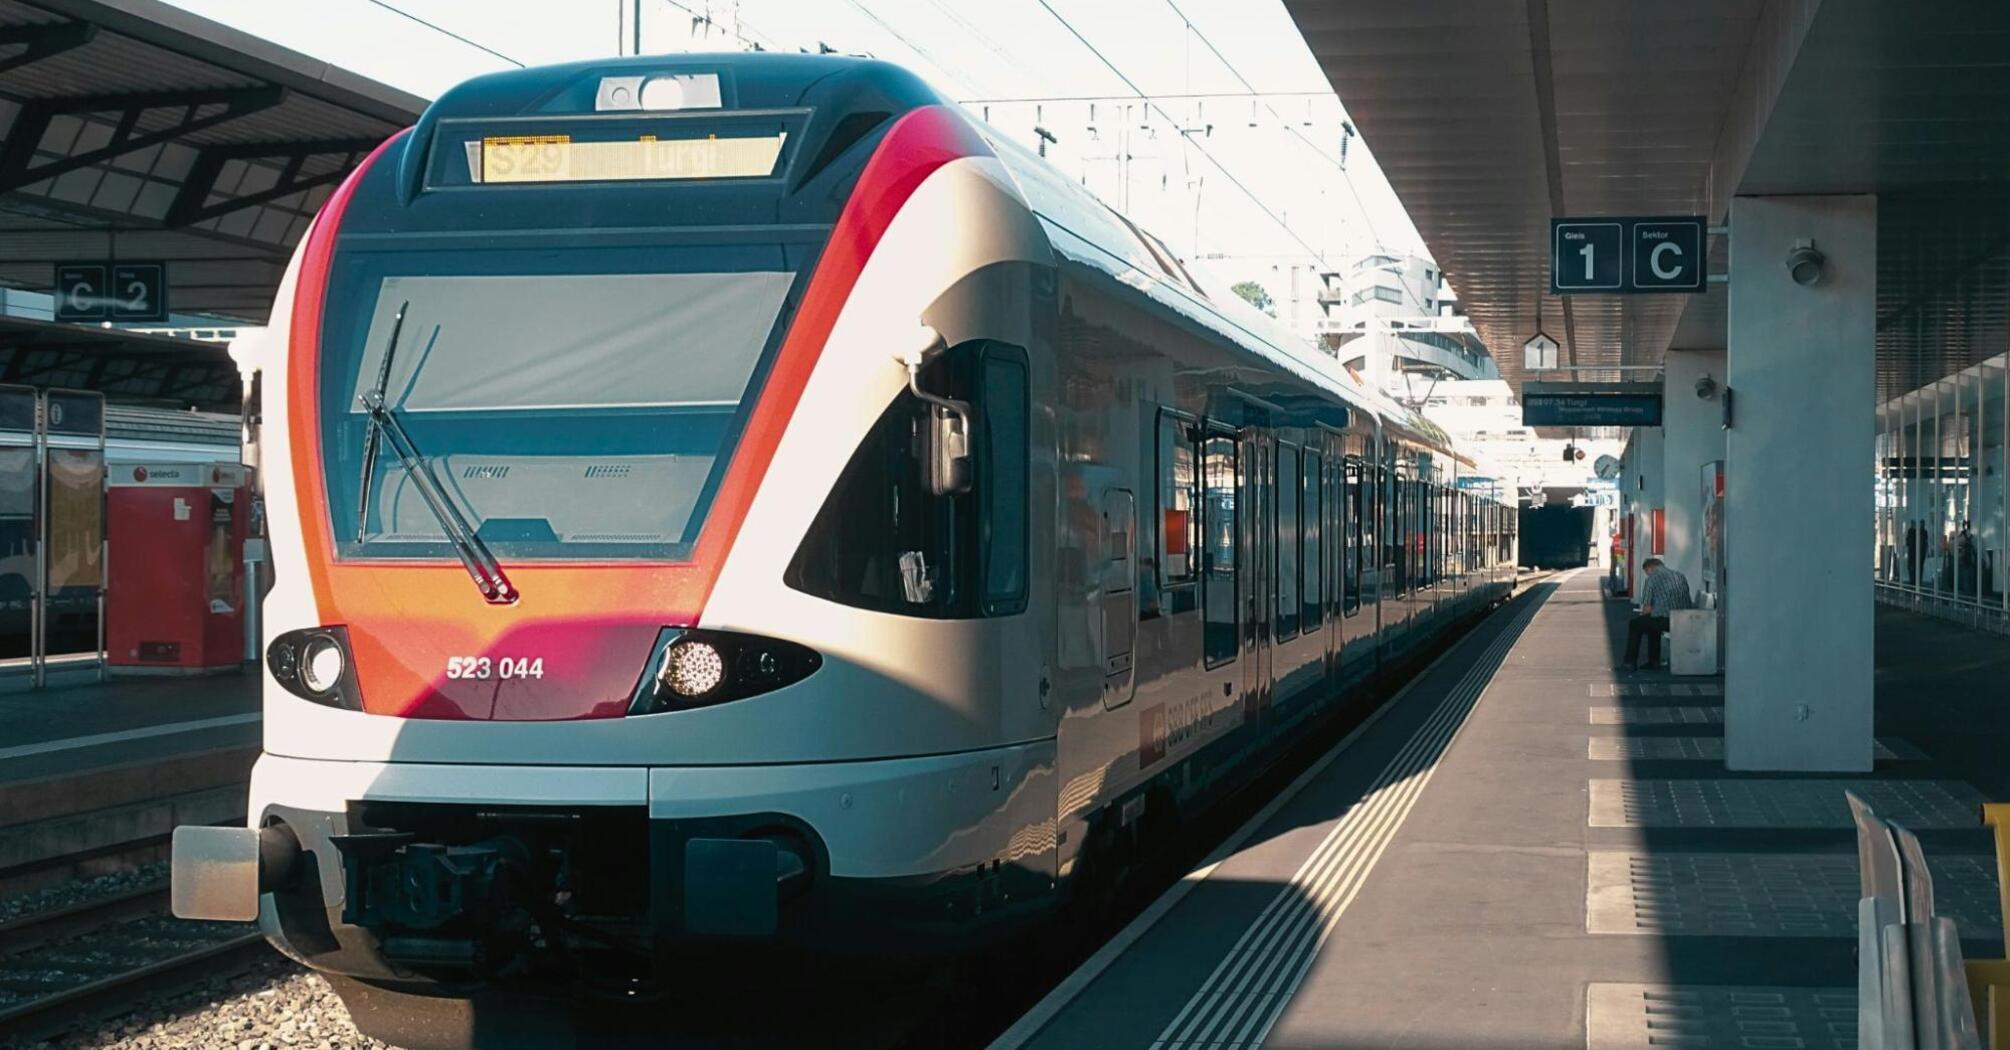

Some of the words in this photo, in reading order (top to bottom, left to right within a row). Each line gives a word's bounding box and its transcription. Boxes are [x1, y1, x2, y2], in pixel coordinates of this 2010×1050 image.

[491, 139, 563, 175] S29
[1564, 232, 1585, 240] Gleis
[1642, 231, 1669, 239] Sektor
[1579, 243, 1594, 280] 1
[1650, 241, 1683, 280] C
[71, 282, 94, 312] C
[127, 281, 148, 311] 2
[1536, 341, 1544, 368] 1
[149, 469, 180, 479] selecta
[446, 655, 491, 680] 523
[499, 656, 544, 680] 044
